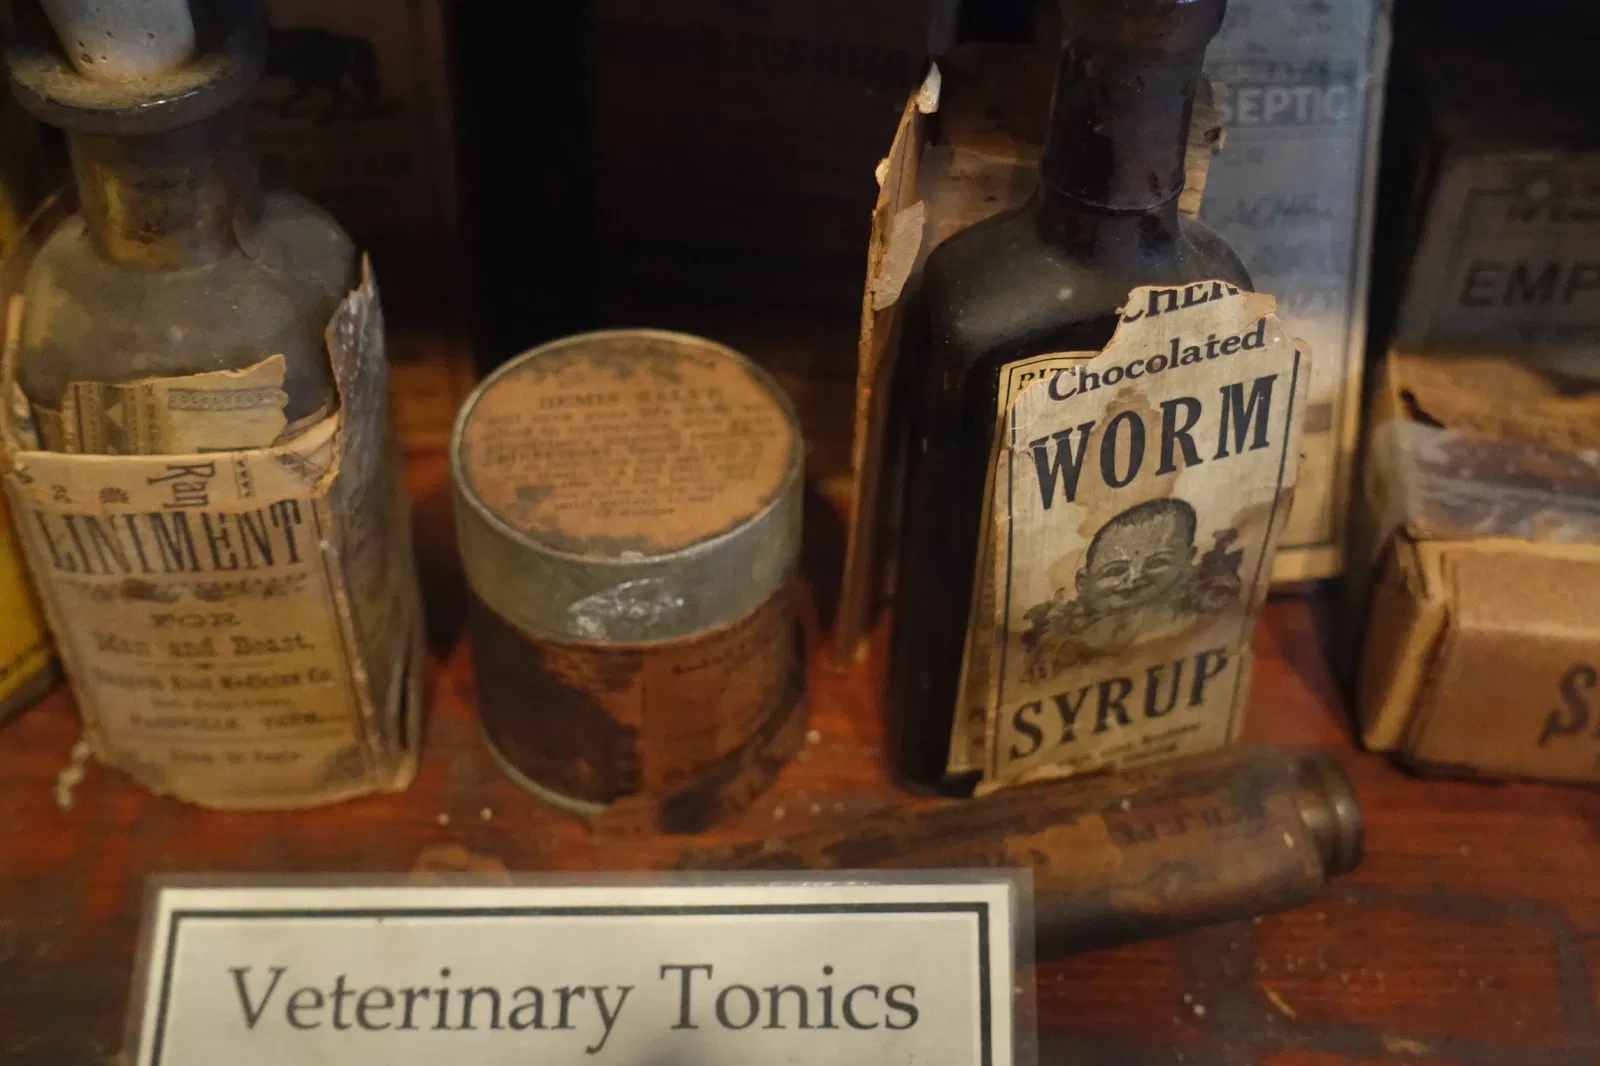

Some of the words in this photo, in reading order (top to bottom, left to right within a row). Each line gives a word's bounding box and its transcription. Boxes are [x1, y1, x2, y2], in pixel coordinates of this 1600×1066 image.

[1048, 316, 1267, 401] Chocolated
[1029, 374, 1278, 511] WORM
[36, 500, 304, 574] LINIMENT
[150, 612, 242, 628] FOR
[167, 636, 217, 656] and
[1010, 647, 1227, 761] SYRUP
[1537, 664, 1600, 748] S
[229, 966, 634, 1055] Veterinary
[660, 964, 920, 1032] Tonics
